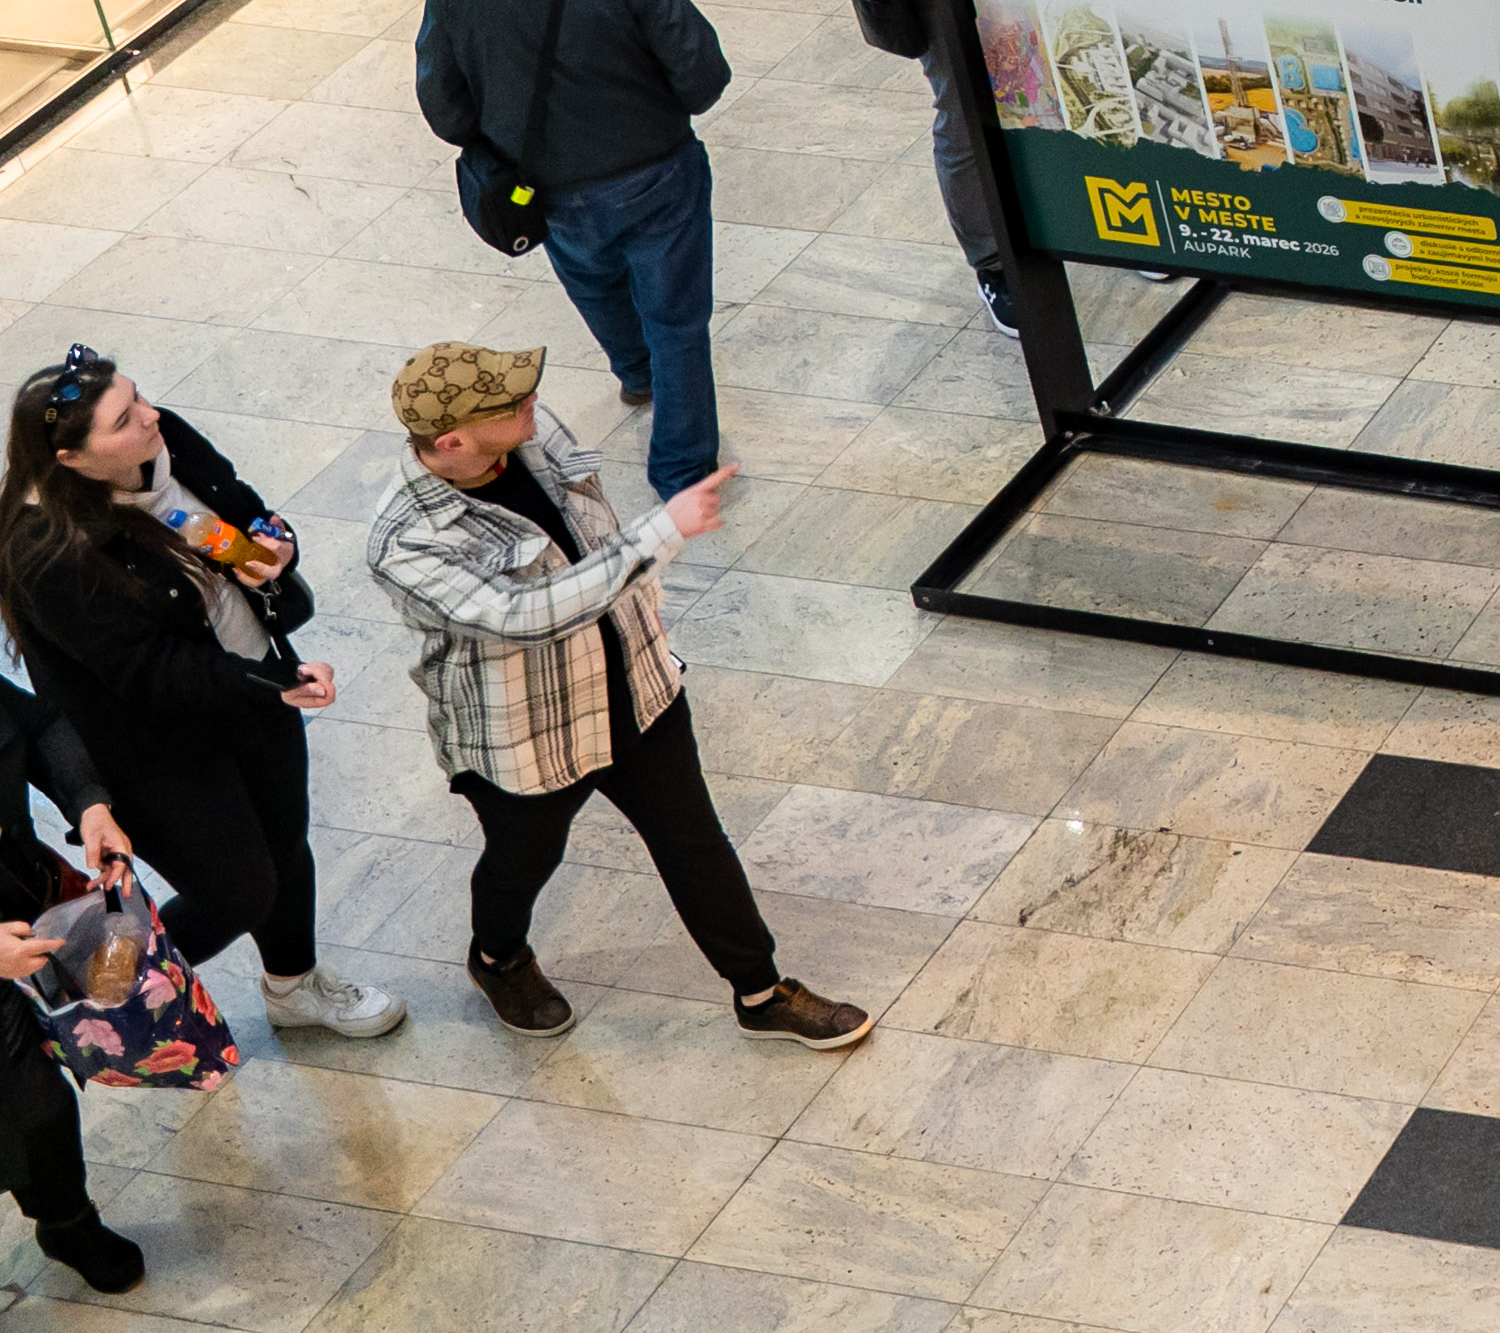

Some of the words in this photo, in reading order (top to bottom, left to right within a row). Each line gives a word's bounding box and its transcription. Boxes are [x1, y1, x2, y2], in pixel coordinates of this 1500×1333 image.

[1170, 186, 1252, 212] MESTO
[1175, 205, 1193, 221] V
[1198, 208, 1277, 233] MESTE
[1179, 223, 1198, 237] 9.
[1211, 226, 1240, 241] 22.
[1242, 233, 1300, 250] marec
[1303, 240, 1340, 256] 2026
[1184, 239, 1252, 259] AUPARK
